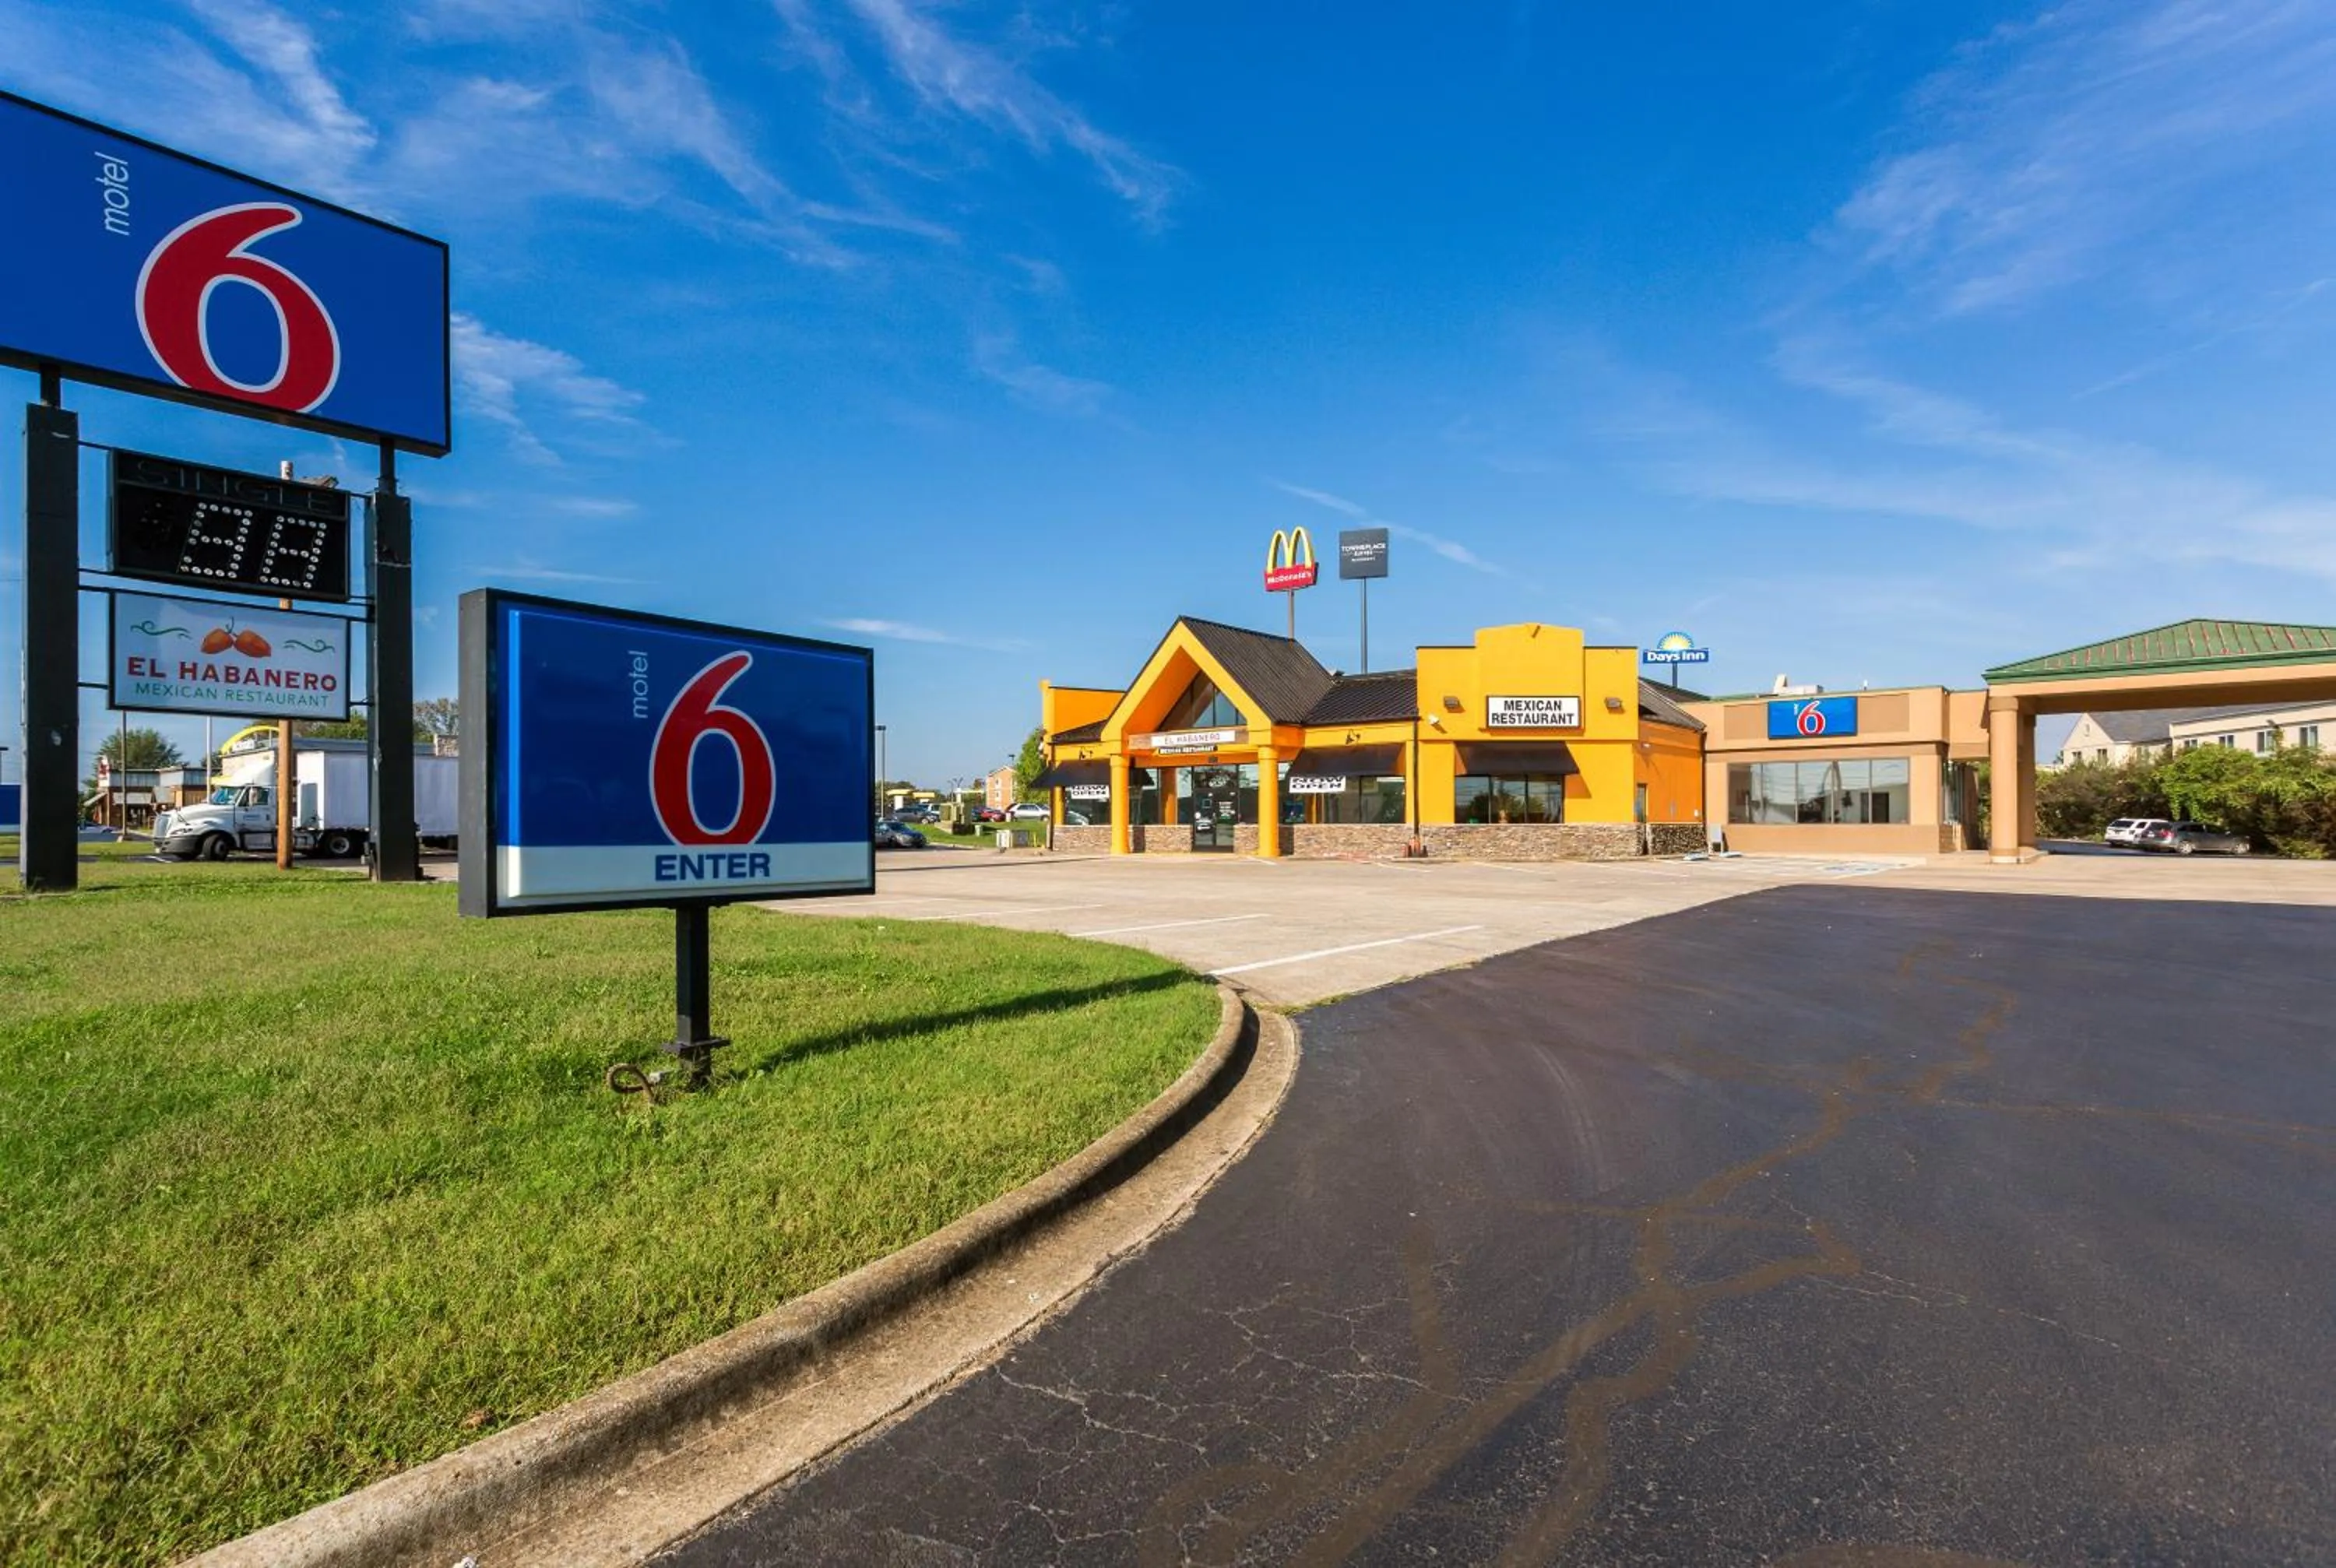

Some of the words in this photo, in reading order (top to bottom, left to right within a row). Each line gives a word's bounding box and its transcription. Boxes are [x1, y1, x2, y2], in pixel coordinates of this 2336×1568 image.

[94, 151, 129, 236] motel
[135, 202, 340, 413] 6
[1647, 652, 1680, 662] Days
[128, 656, 166, 678] EL
[178, 661, 337, 692] HABANERO
[628, 650, 648, 719] motel
[135, 682, 217, 699] MEXICAN
[225, 689, 329, 708] RESTAURANT
[1504, 700, 1562, 711] MEXICAN
[1491, 713, 1574, 724] RESTAURANT
[1797, 701, 1826, 735] 6
[649, 650, 776, 846] 6
[1177, 733, 1220, 743] HABANERO
[655, 853, 771, 881] ENTER
